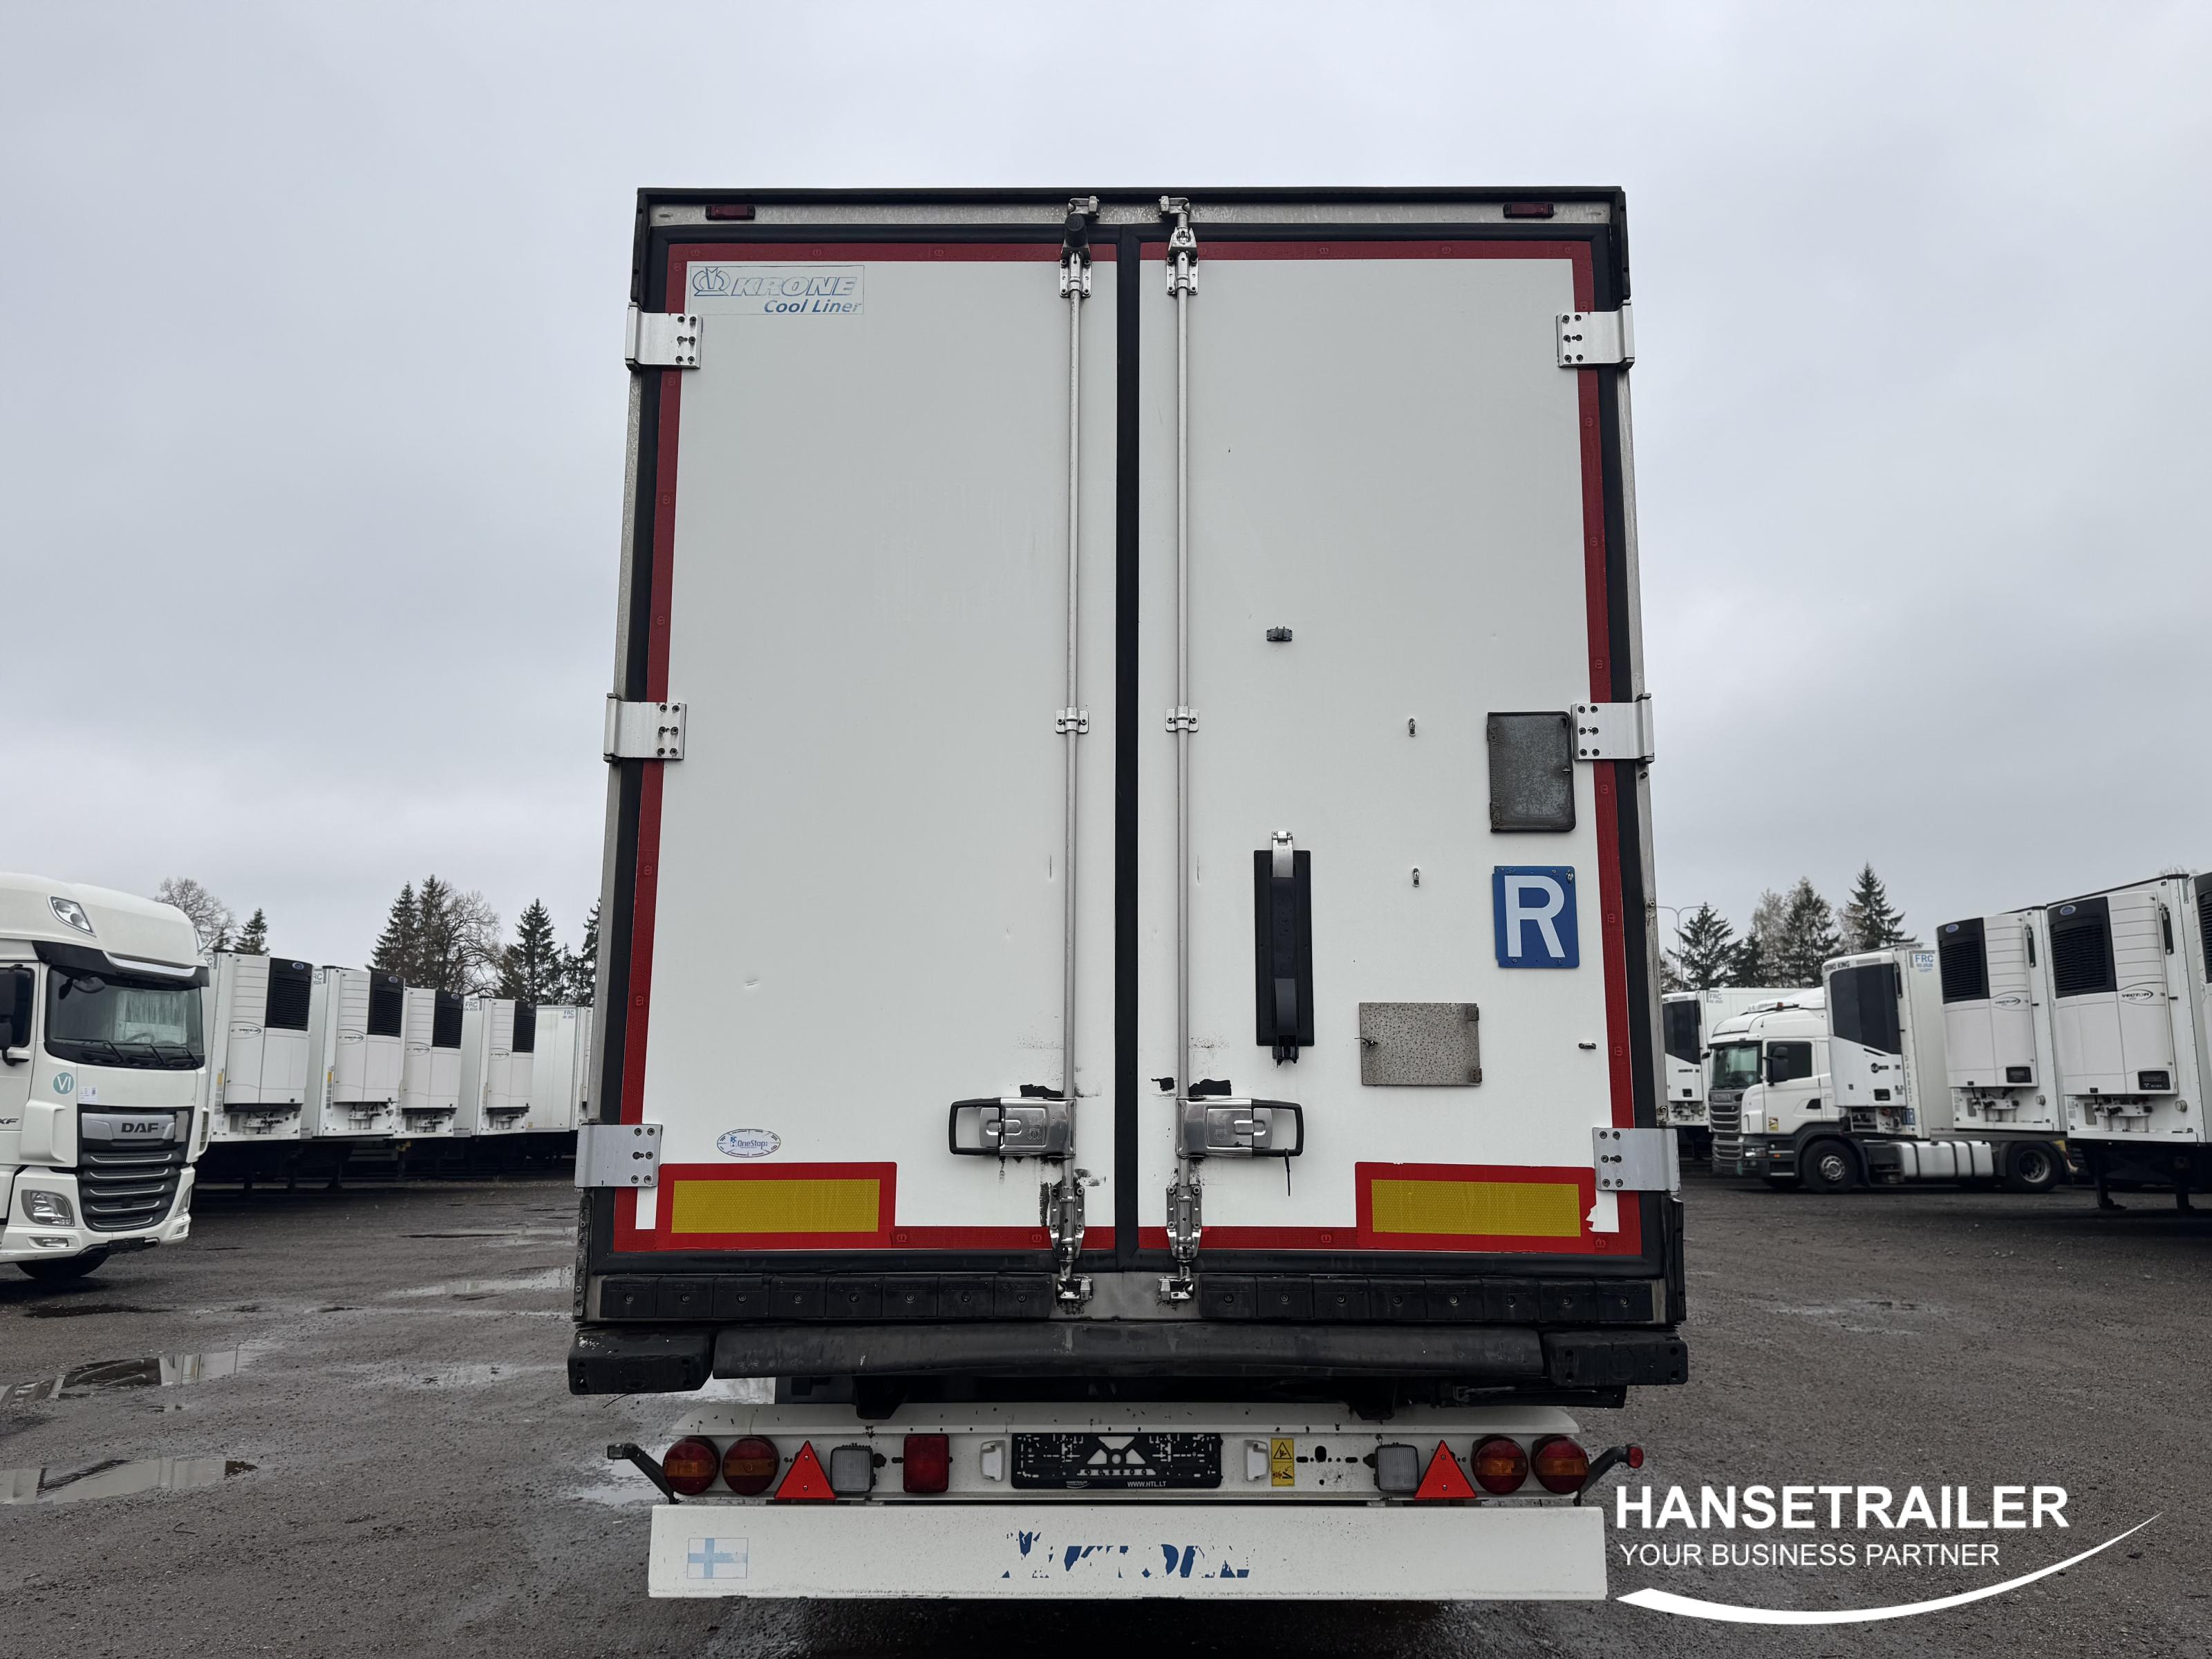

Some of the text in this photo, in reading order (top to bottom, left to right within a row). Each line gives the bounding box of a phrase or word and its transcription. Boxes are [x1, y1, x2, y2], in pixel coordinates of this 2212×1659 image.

[731, 276, 858, 297] KRONE
[764, 299, 862, 313] Cool Liner
[1504, 875, 1566, 958] R
[1915, 955, 1934, 963] FRC
[57, 1076, 71, 1091] VI
[121, 1123, 158, 1133] DAF
